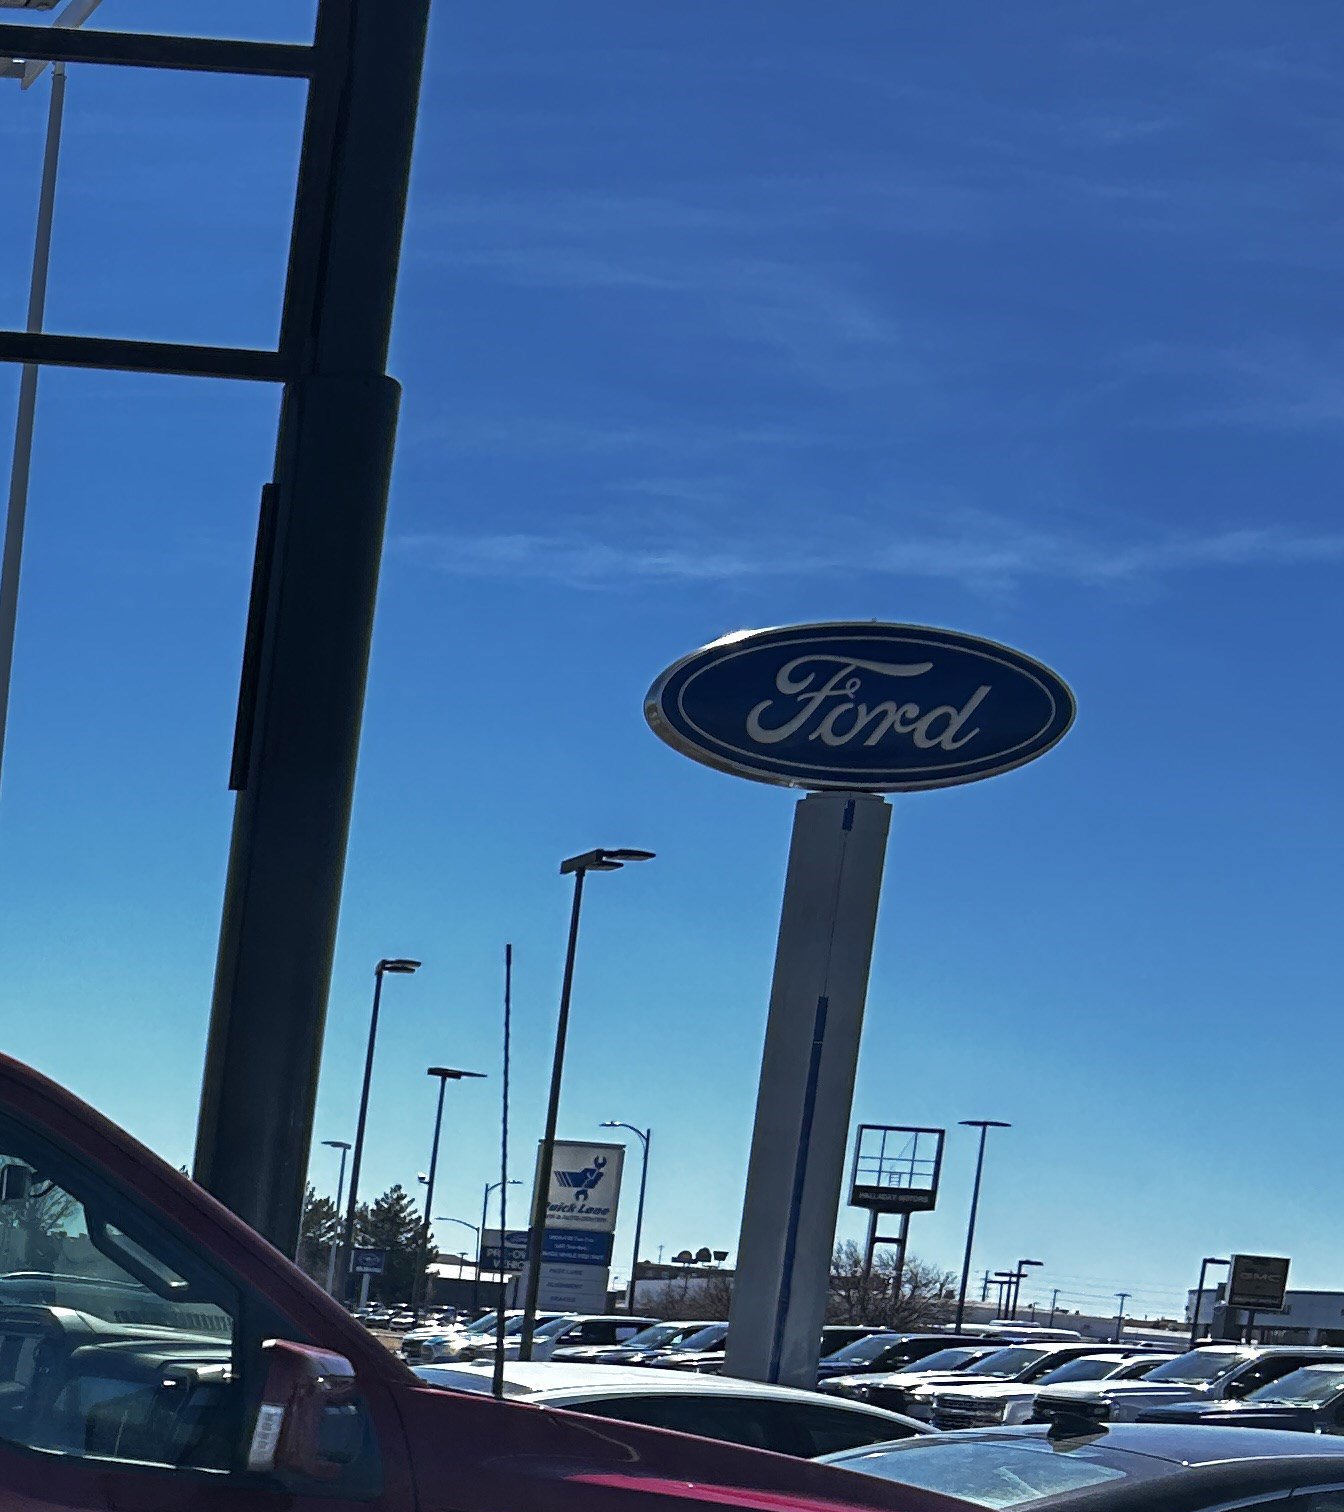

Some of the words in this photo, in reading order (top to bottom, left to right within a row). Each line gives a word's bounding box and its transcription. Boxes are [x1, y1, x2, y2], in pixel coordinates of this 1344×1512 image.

[746, 653, 992, 751] Ford
[577, 1204, 610, 1215] Lane
[1240, 1272, 1282, 1282] GMC
